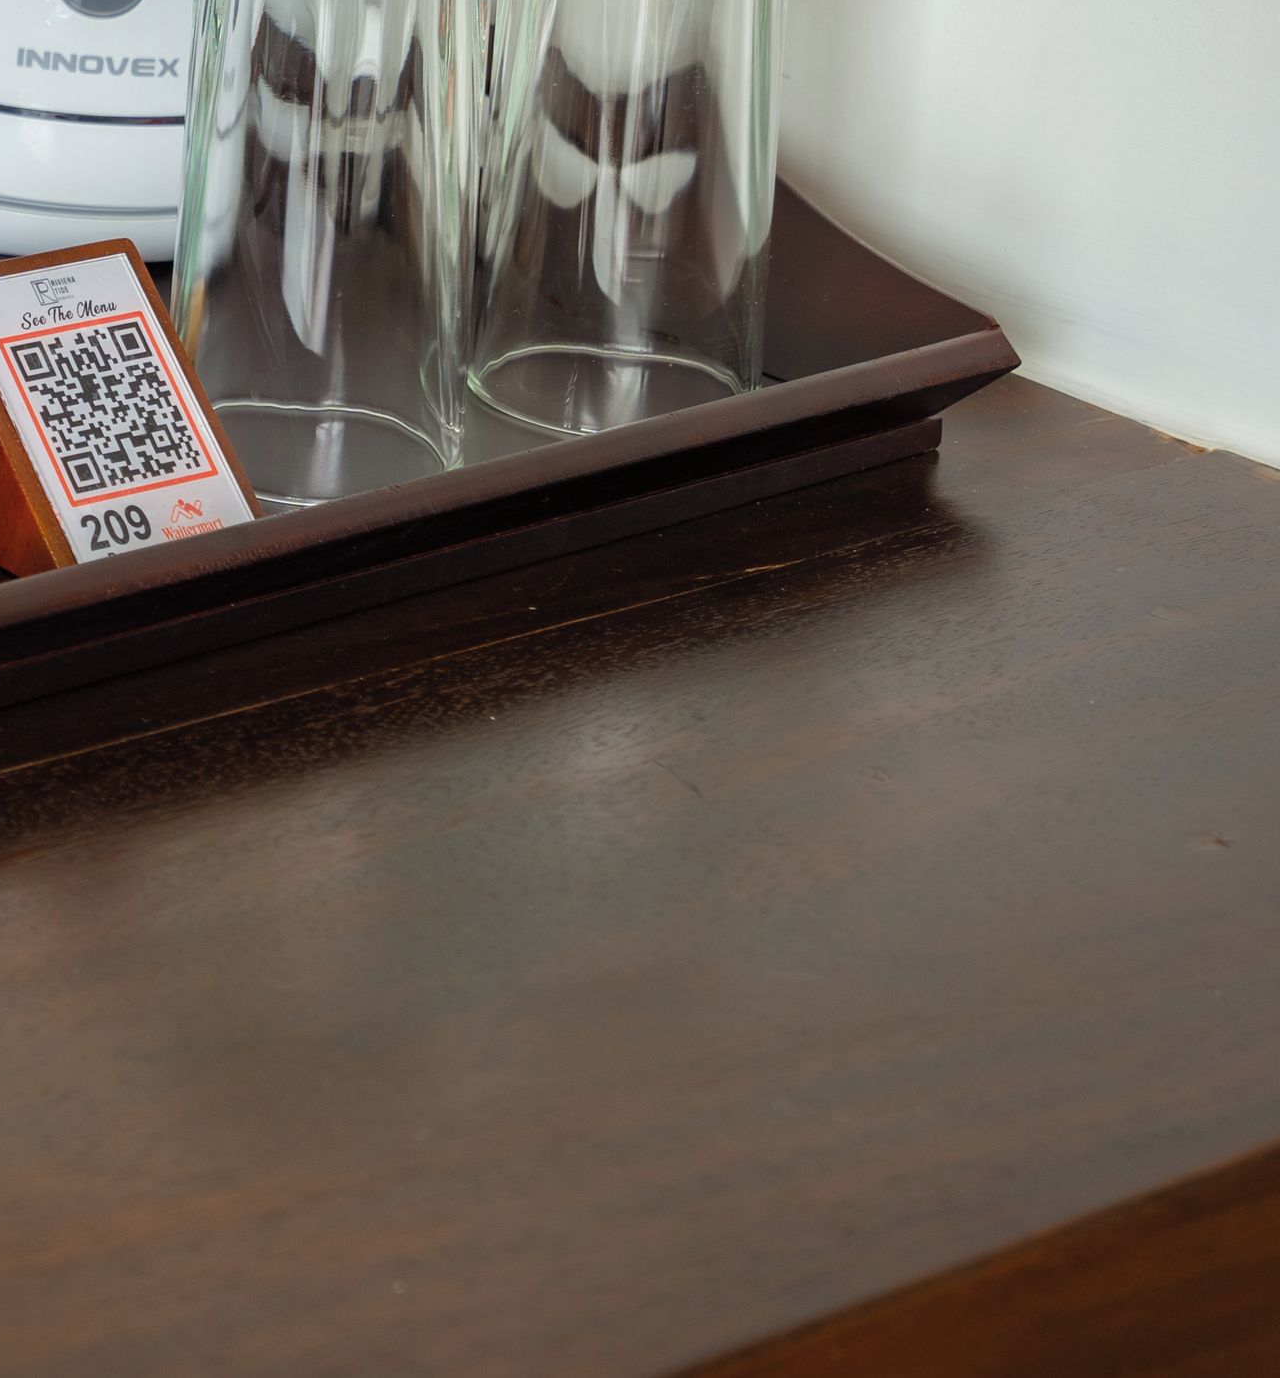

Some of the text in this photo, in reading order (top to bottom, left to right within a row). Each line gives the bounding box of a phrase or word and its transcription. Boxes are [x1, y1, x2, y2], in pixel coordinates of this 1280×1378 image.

[16, 47, 180, 78] INNOVEX
[21, 299, 117, 330] See The Menu
[80, 504, 152, 552] 209
